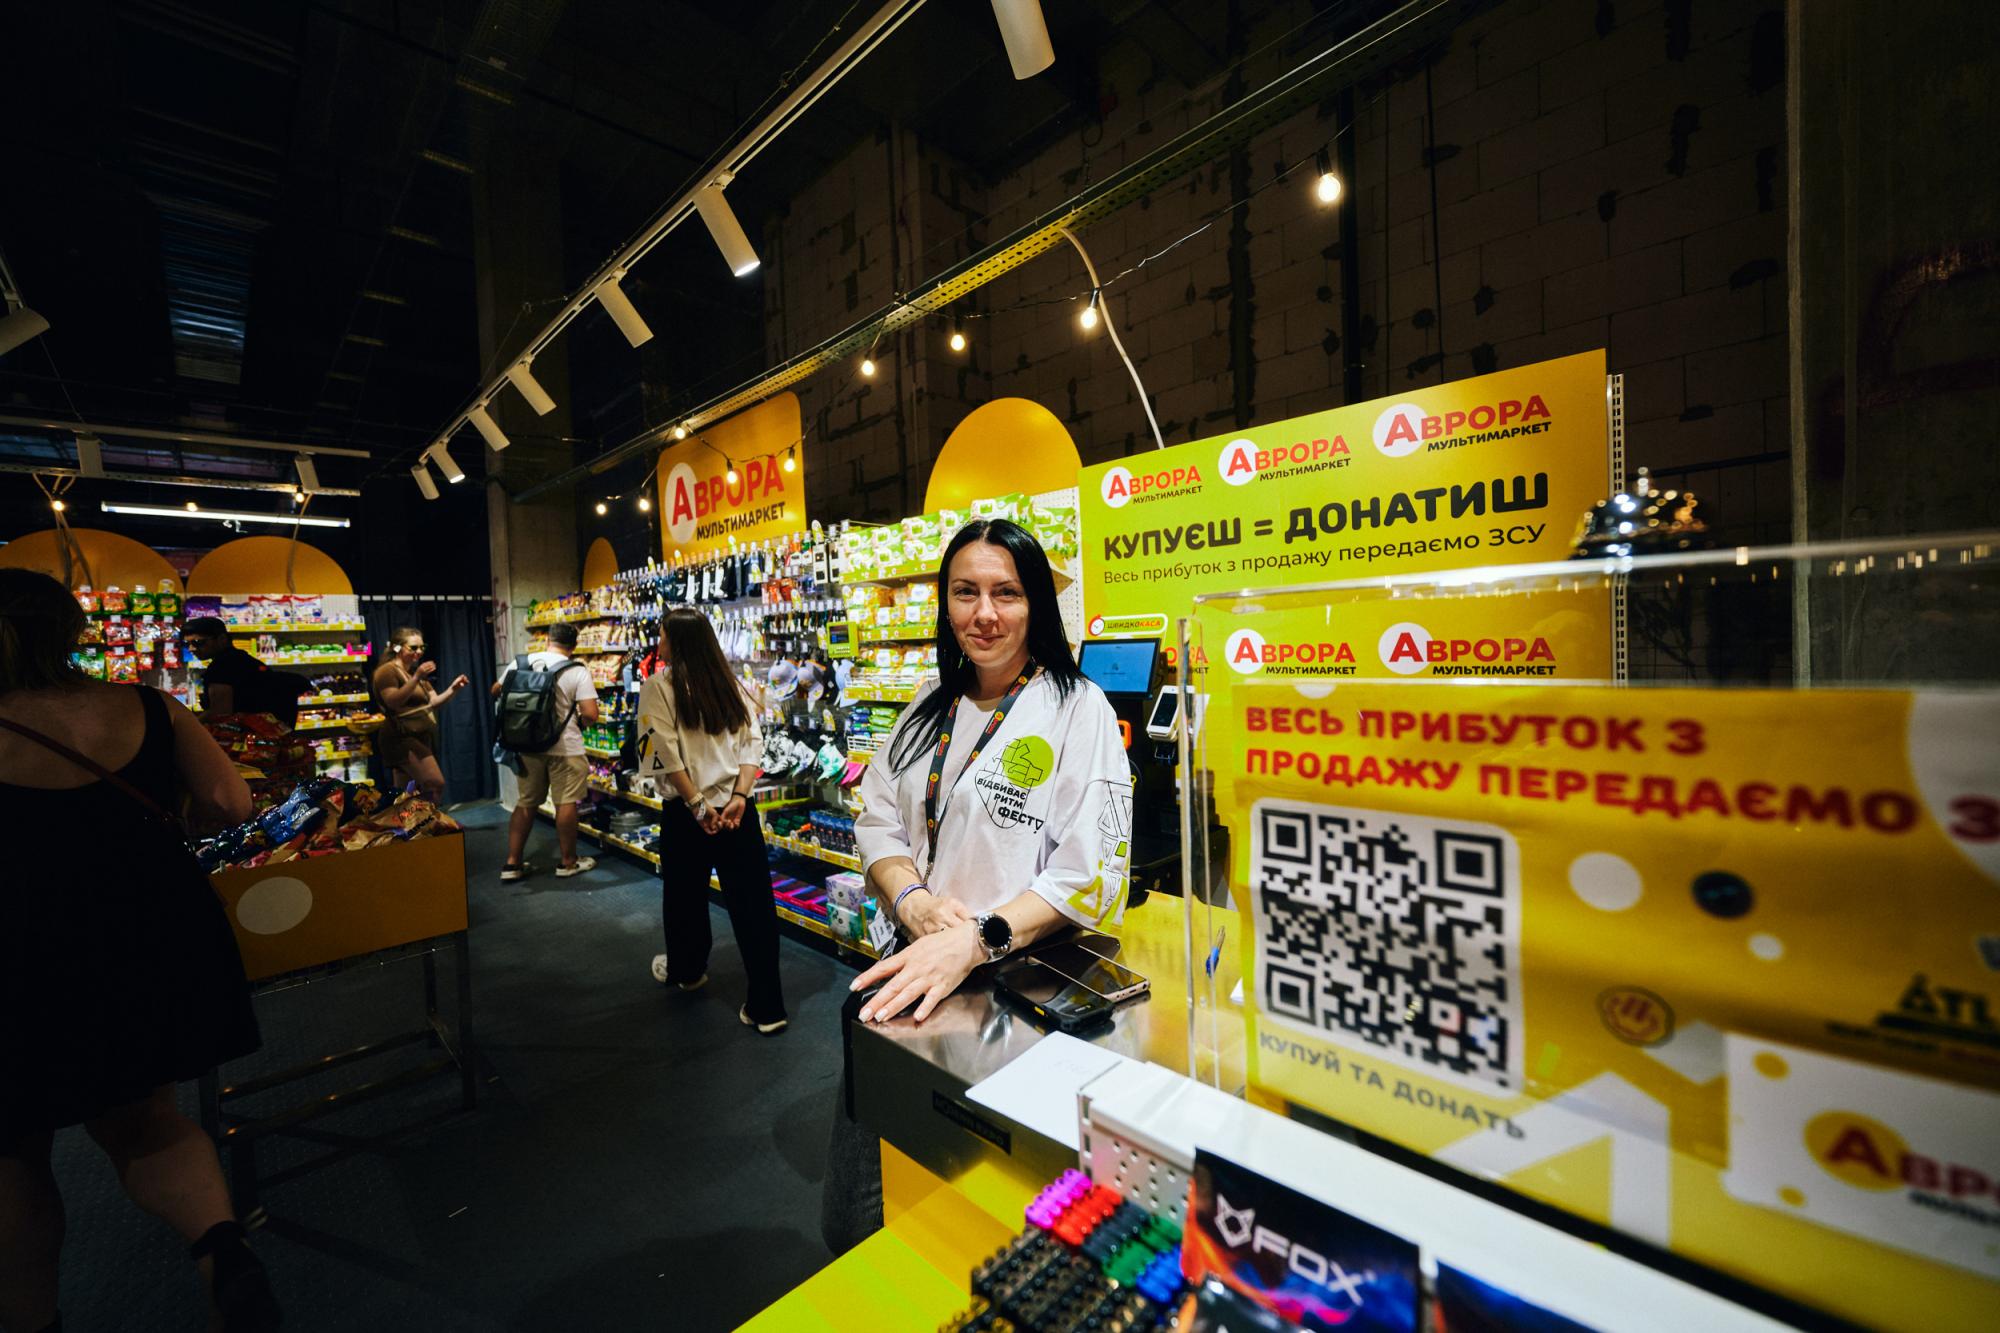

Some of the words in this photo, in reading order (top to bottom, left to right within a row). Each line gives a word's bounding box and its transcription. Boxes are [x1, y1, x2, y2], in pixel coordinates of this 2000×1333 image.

[1384, 395, 1552, 447] АВРОРА
[1427, 421, 1552, 452] МУЛЬТИМАРКЕТ
[1227, 435, 1350, 477] АВРОРА
[1259, 457, 1351, 481] МУЛЬТИМАРКЕТ
[1107, 465, 1202, 500] АВРОРА
[1132, 485, 1203, 505] МУЛЬТИМАРКЕТ
[696, 501, 786, 541] МУЛЬТИМАРКЕТ
[1103, 516, 1242, 561] КУПУЄШ
[1253, 518, 1274, 537] =
[1284, 472, 1549, 545] ДОНАТИШ
[1103, 570, 1139, 584] Весь
[1143, 561, 1222, 582] прибуток
[1226, 560, 1237, 572] з
[1241, 549, 1332, 571] продажу
[1339, 534, 1480, 563] передаємо
[1488, 523, 1547, 547] ЗСУ
[1233, 637, 1357, 664] АВРОРА
[1389, 632, 1556, 663] АВРОРА
[1265, 665, 1357, 675] МУЛЬТИМАРКЕТ
[1432, 664, 1557, 676] МУЛЬТИМАРКЕТ
[1246, 706, 1345, 736] ВЕСЬ
[1357, 709, 1646, 753] ПРИБУТОК
[976, 778, 1027, 800] ВІДБИВАЄ
[993, 793, 1024, 810] РИТМ
[1246, 748, 1461, 791] ПРОДАЖУ
[1479, 764, 1919, 835] ПЕРЕДАЄМО
[1259, 1031, 1341, 1074] КУПУЙ
[1350, 1062, 1386, 1091] ТА
[1393, 1079, 1526, 1140] ДОНАТЬ
[1822, 1124, 2000, 1208] АВР
[1252, 1225, 1365, 1306] FOX
